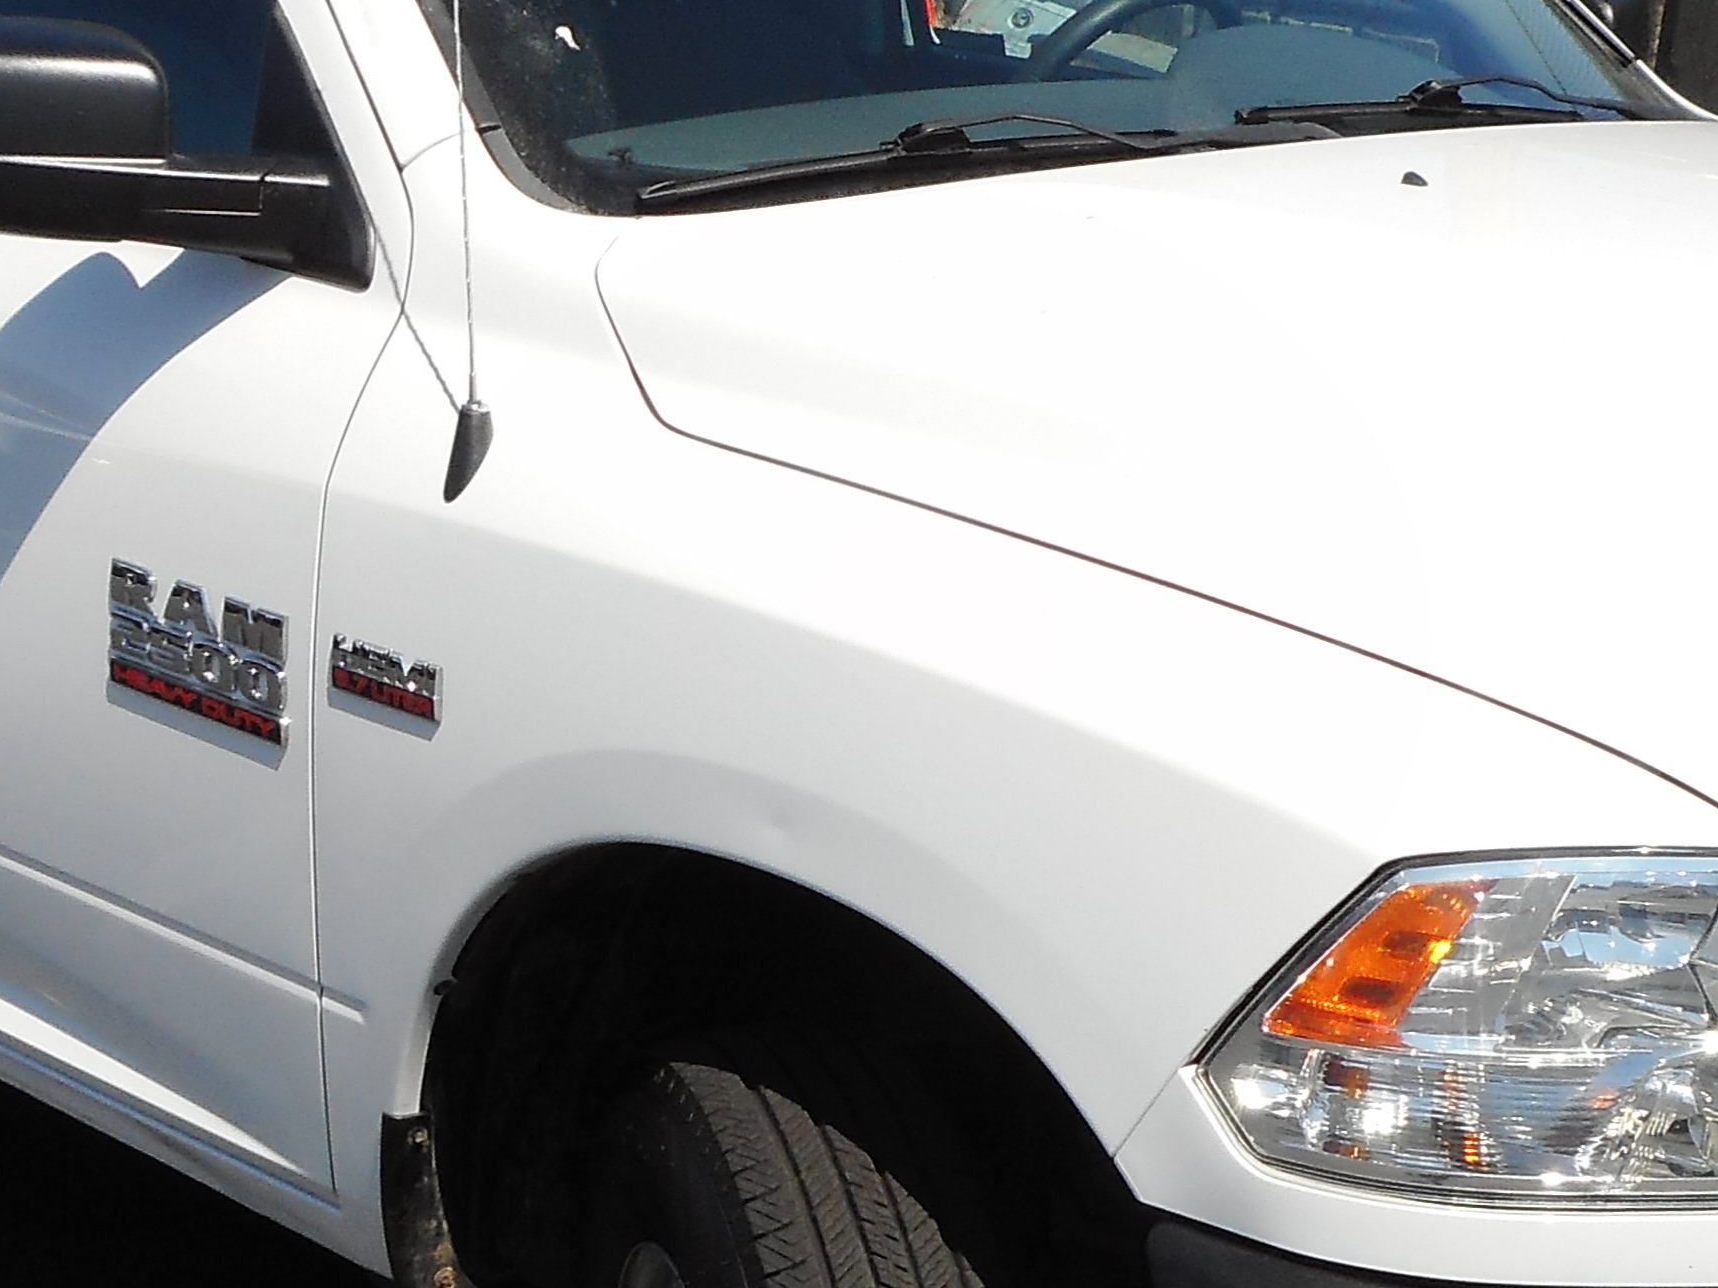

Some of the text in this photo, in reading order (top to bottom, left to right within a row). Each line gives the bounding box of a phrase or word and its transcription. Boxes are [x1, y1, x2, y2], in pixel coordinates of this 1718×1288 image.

[108, 556, 289, 667] RAM
[113, 663, 276, 737] HEAVY DUTY
